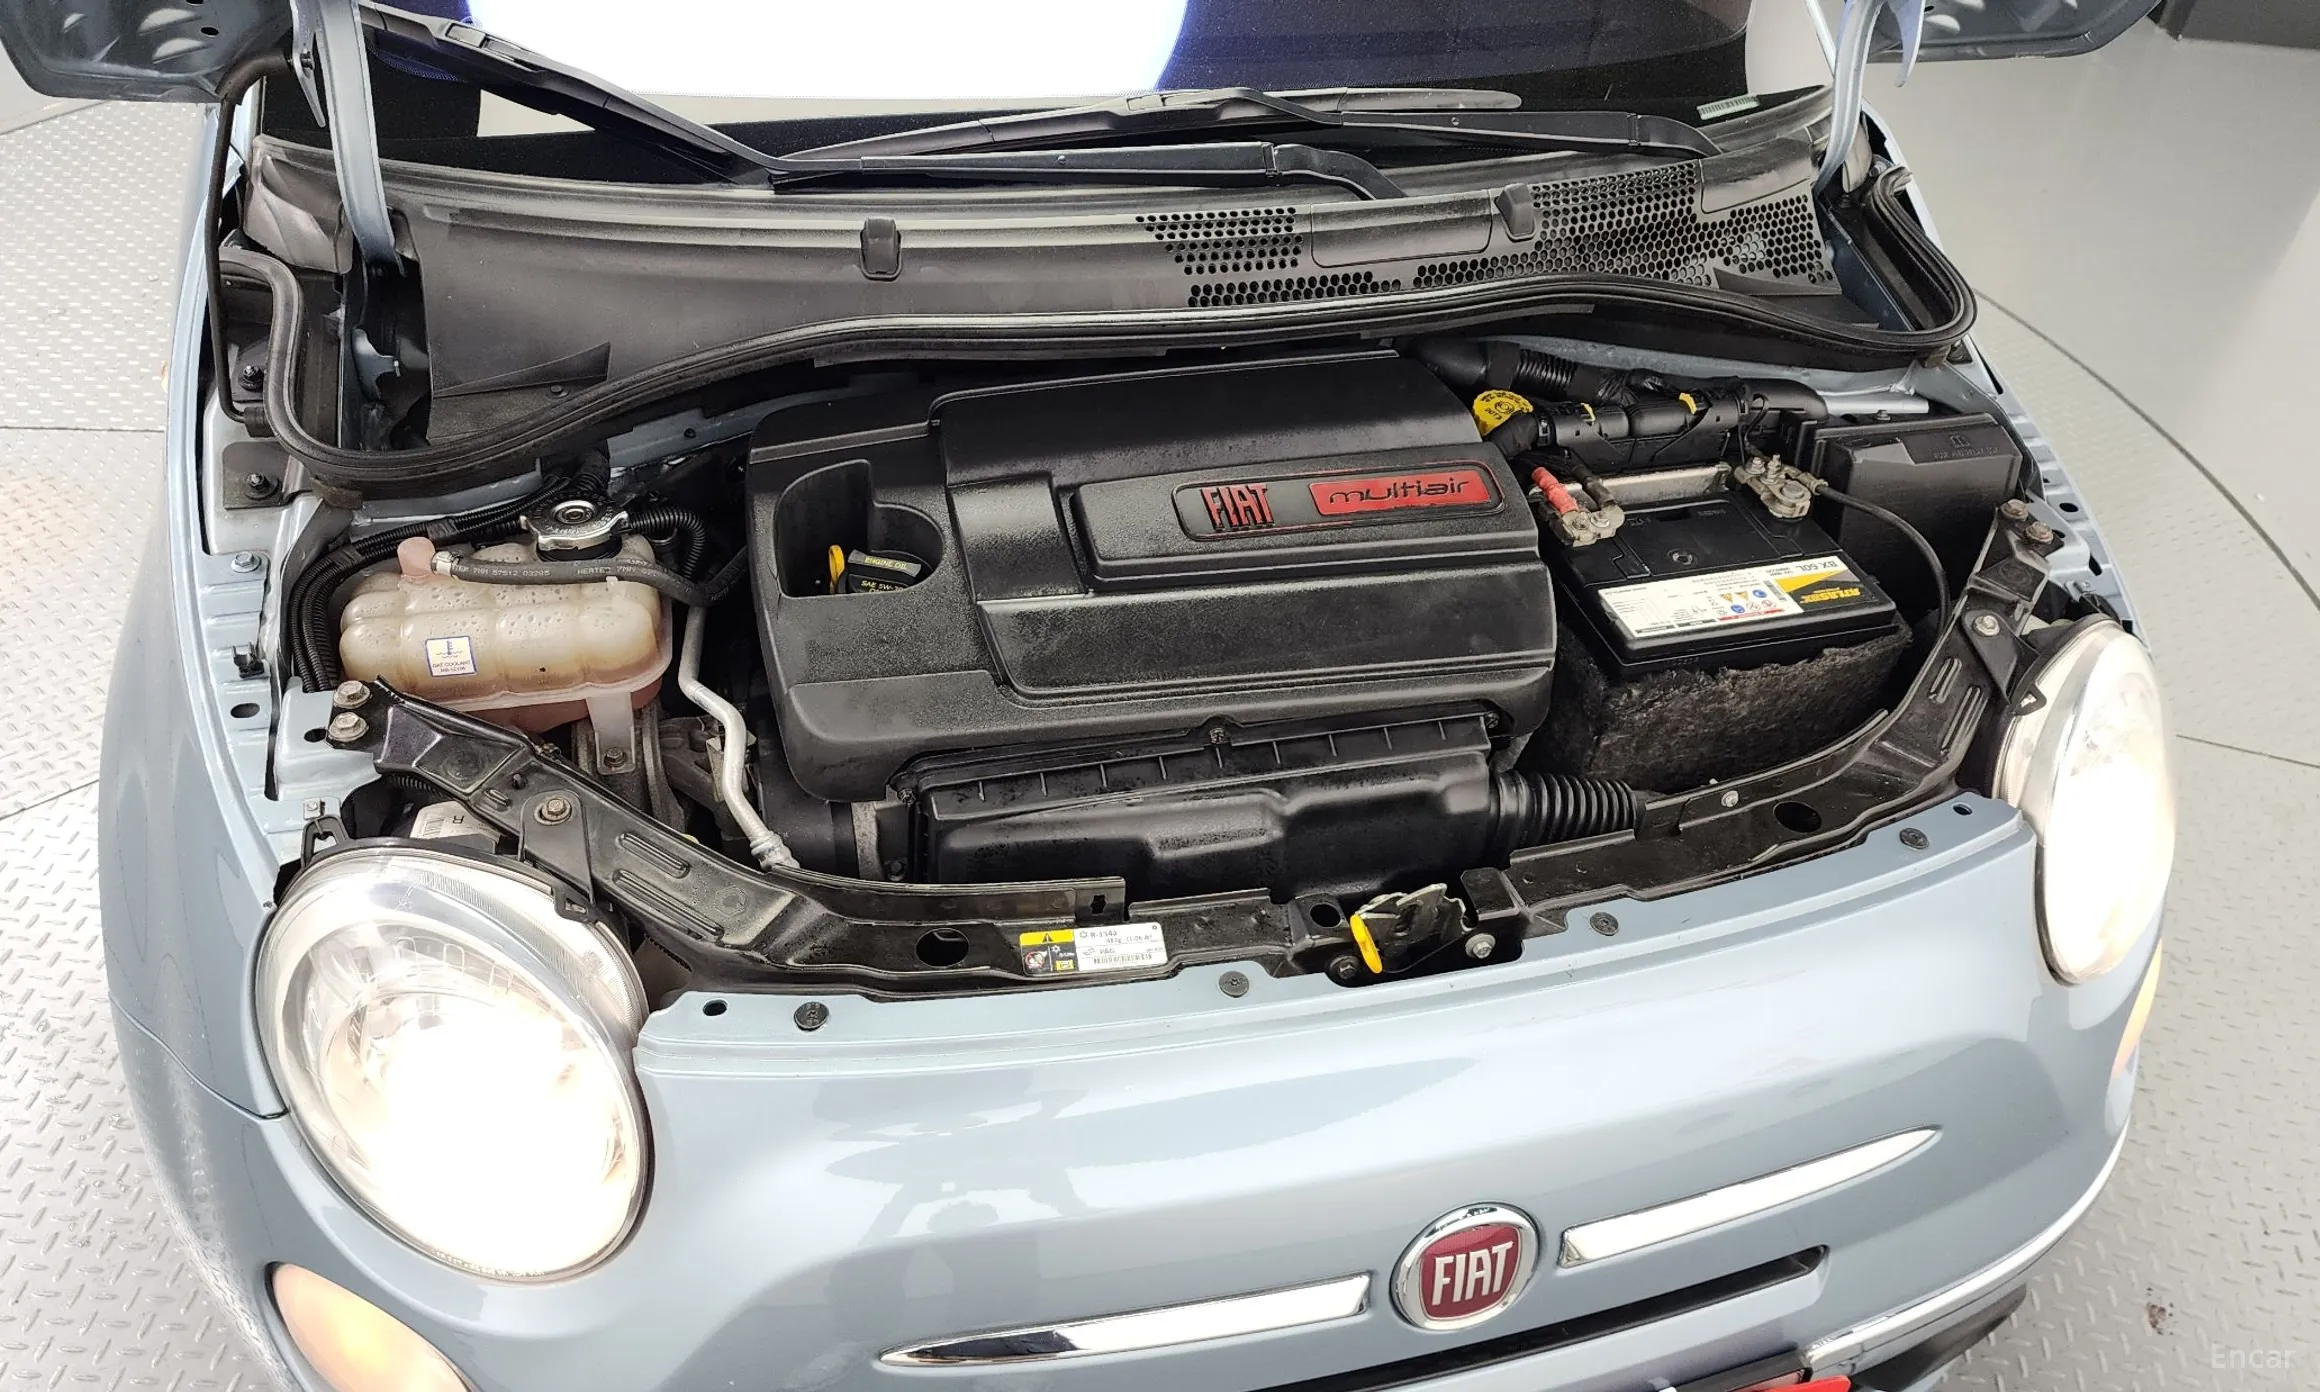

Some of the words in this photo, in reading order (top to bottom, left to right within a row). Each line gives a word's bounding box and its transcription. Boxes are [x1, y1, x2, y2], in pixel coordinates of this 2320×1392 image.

[1201, 482, 1275, 532] FIAT
[1328, 477, 1470, 505] multiair
[865, 557, 894, 567] ENGINE
[452, 815, 465, 824] R
[1431, 1241, 1515, 1306] FIAT
